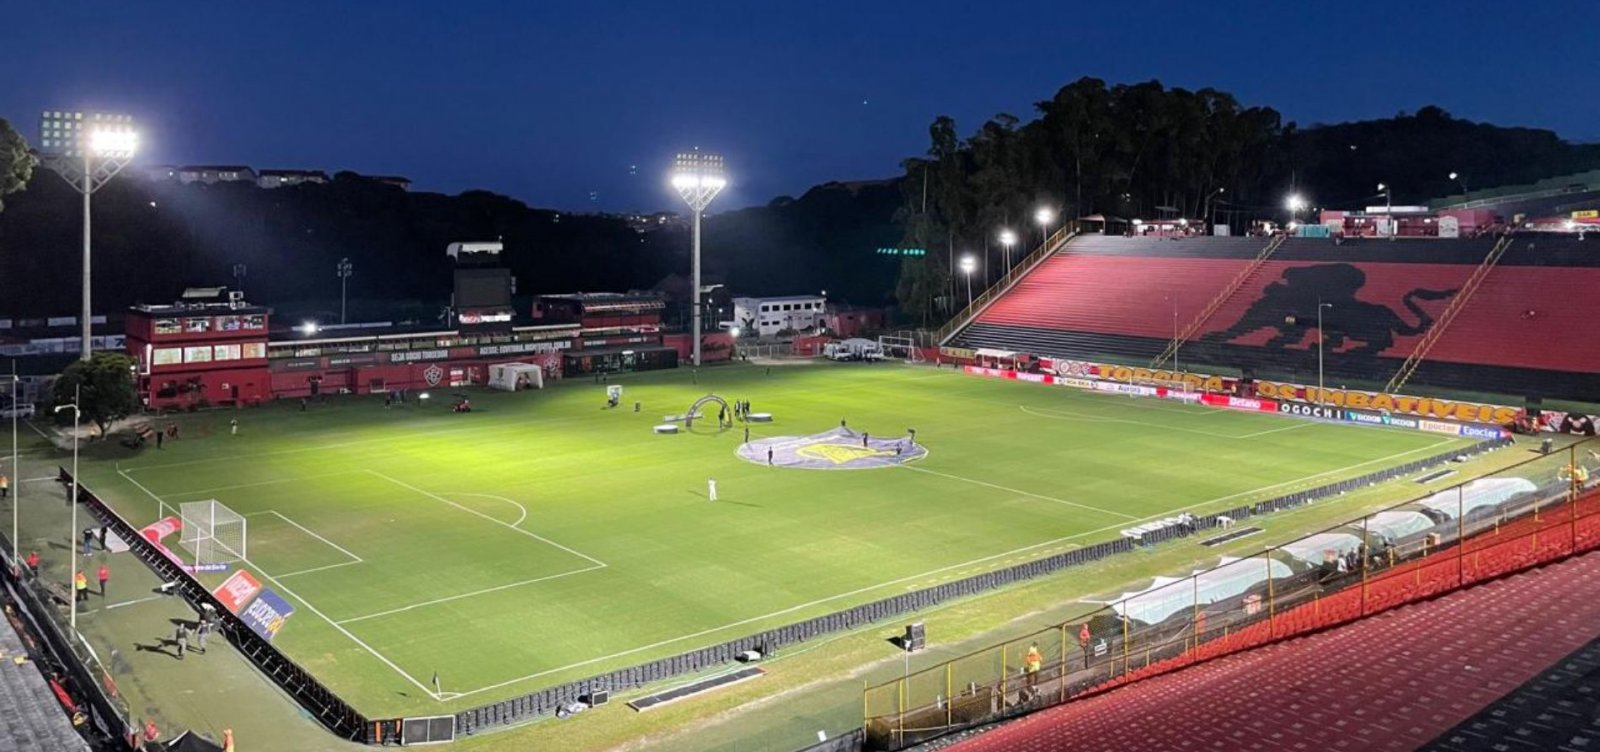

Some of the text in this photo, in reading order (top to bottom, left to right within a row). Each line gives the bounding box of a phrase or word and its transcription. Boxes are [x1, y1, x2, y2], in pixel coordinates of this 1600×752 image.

[1099, 365, 1223, 392] TORCIDA
[1257, 381, 1297, 400] OS
[1281, 403, 1341, 419] OGOCHI
[1423, 422, 1456, 433] Epocler
[1463, 426, 1498, 438] Epocler
